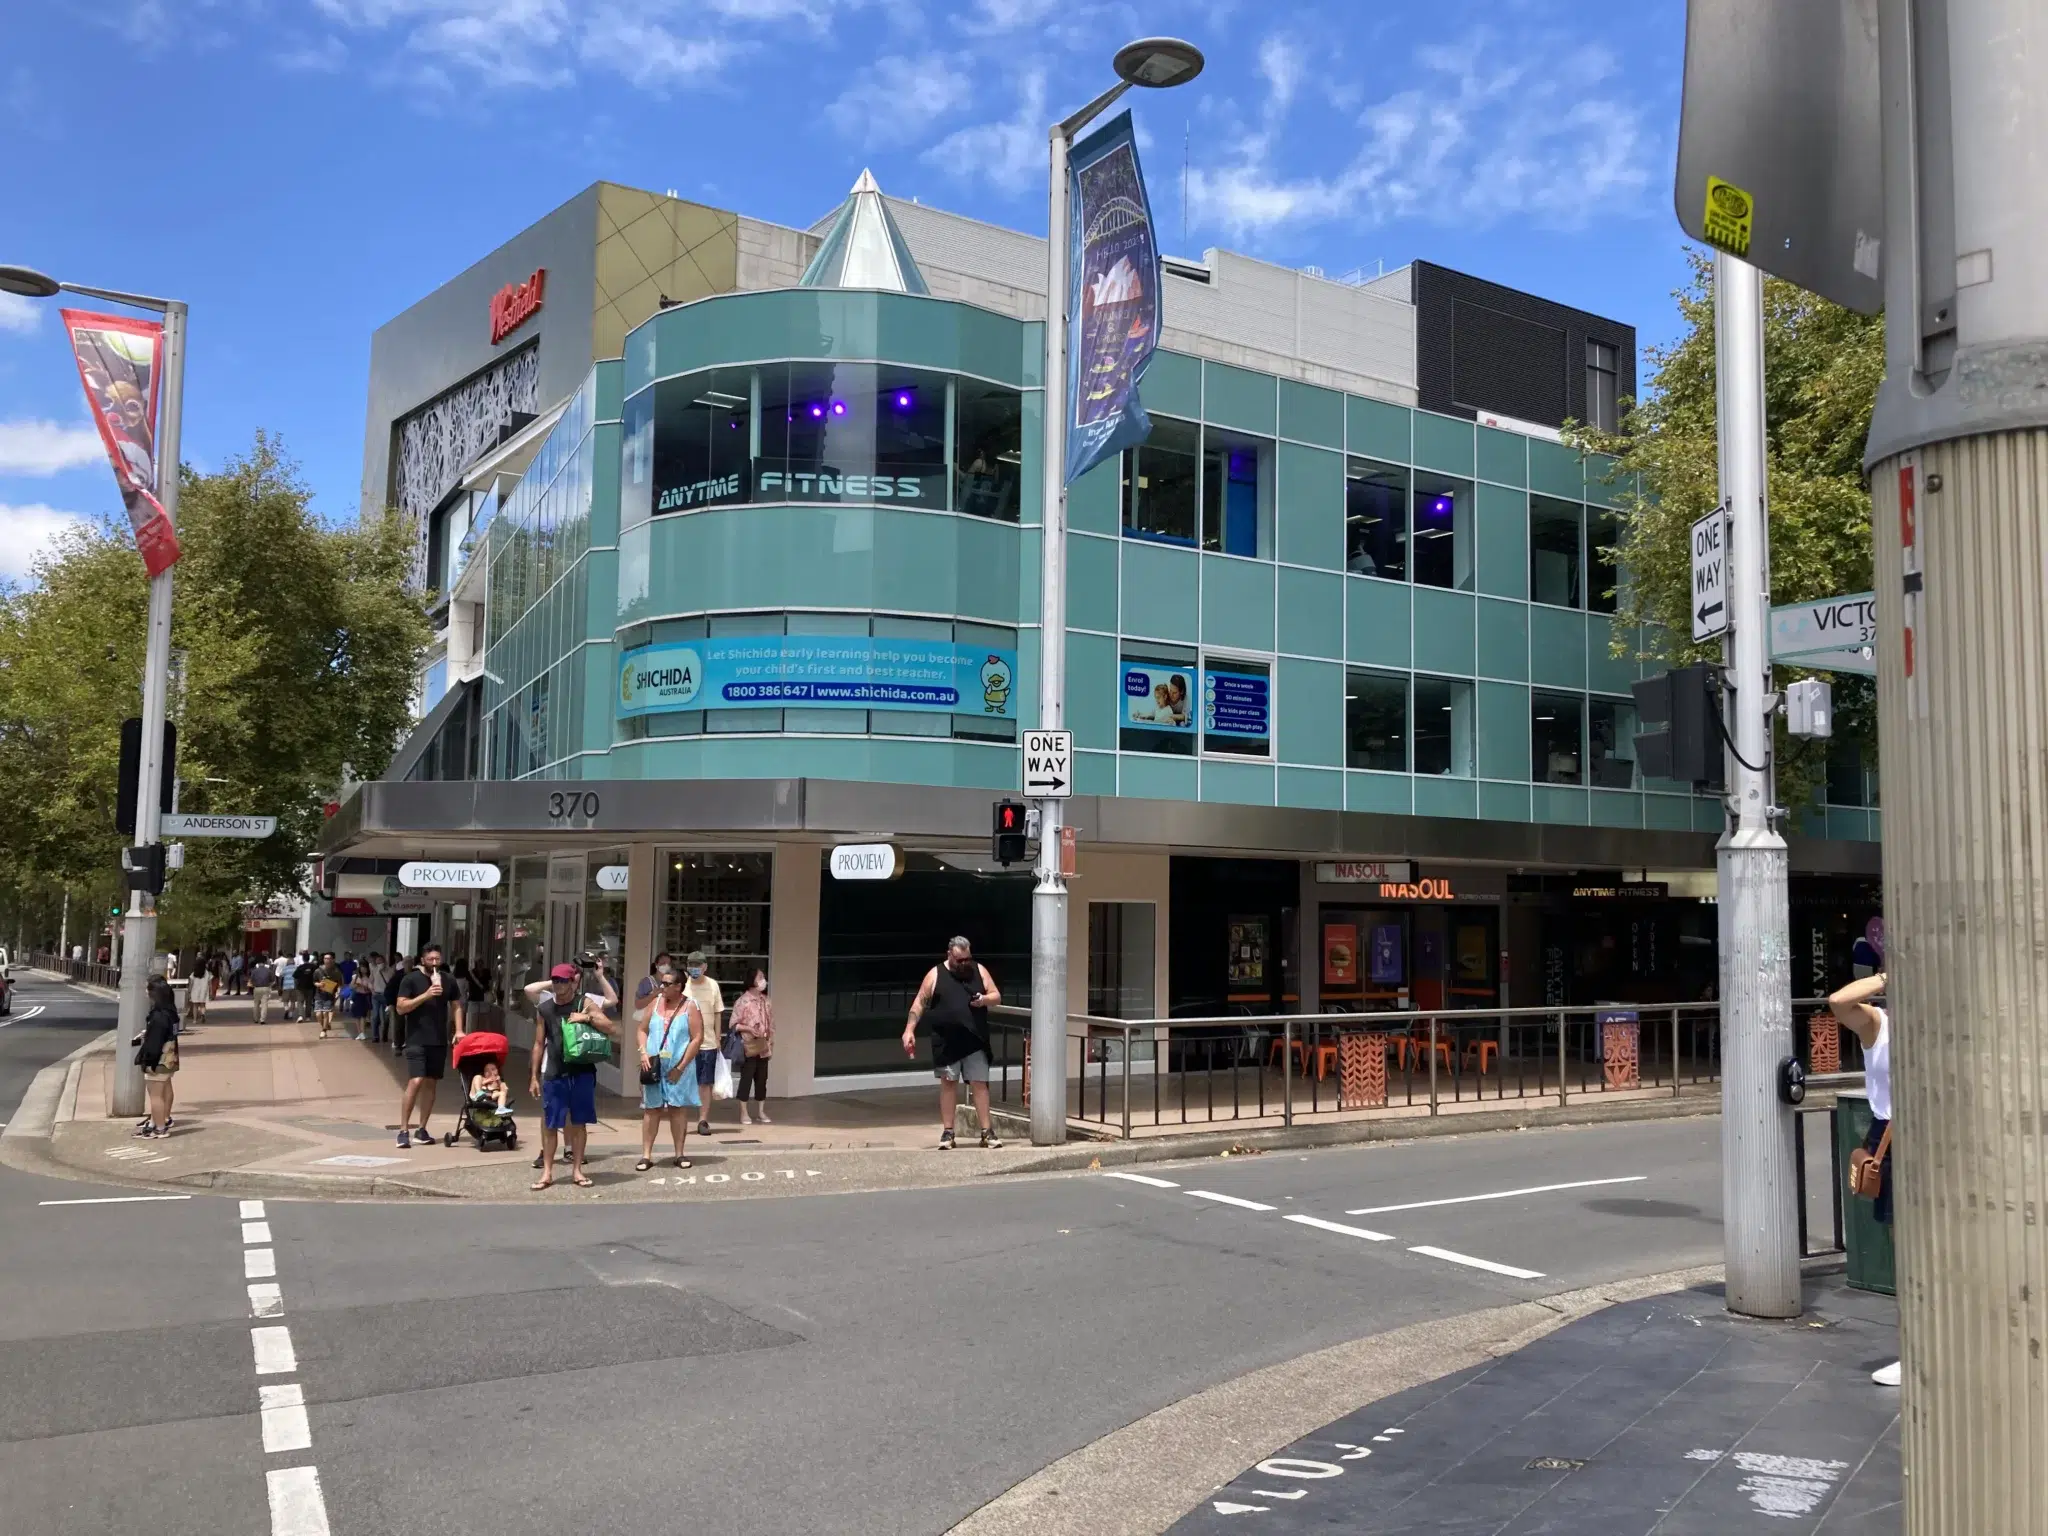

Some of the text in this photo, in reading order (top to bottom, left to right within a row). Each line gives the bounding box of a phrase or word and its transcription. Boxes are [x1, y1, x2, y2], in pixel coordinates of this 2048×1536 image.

[490, 268, 545, 345] Westfield
[658, 472, 921, 510] ANYTIME FITNESS
[1696, 522, 1720, 558] ONE
[1696, 558, 1721, 595] WAY
[708, 647, 973, 666] Let Shichida early learning help you become
[636, 666, 692, 689] SHICHIDA
[735, 662, 946, 680] your child's first and best teacher.
[1127, 676, 1144, 684] Enrol
[659, 686, 692, 697] AUSTRALIA
[727, 686, 955, 702] 1800 386 647 www.shichida.com.au
[1218, 721, 1263, 732] Learn through play
[1030, 737, 1065, 752] ONE
[1027, 758, 1066, 772] WAY
[548, 791, 600, 819] 370
[183, 817, 269, 830] ANDERSON ST
[838, 853, 886, 871] PROVIEW
[413, 868, 487, 883] PROVIEW
[1335, 863, 1389, 879] INASOUL
[1572, 887, 1660, 897] ANYTIME FITNESS
[1812, 928, 1824, 982] VIET
